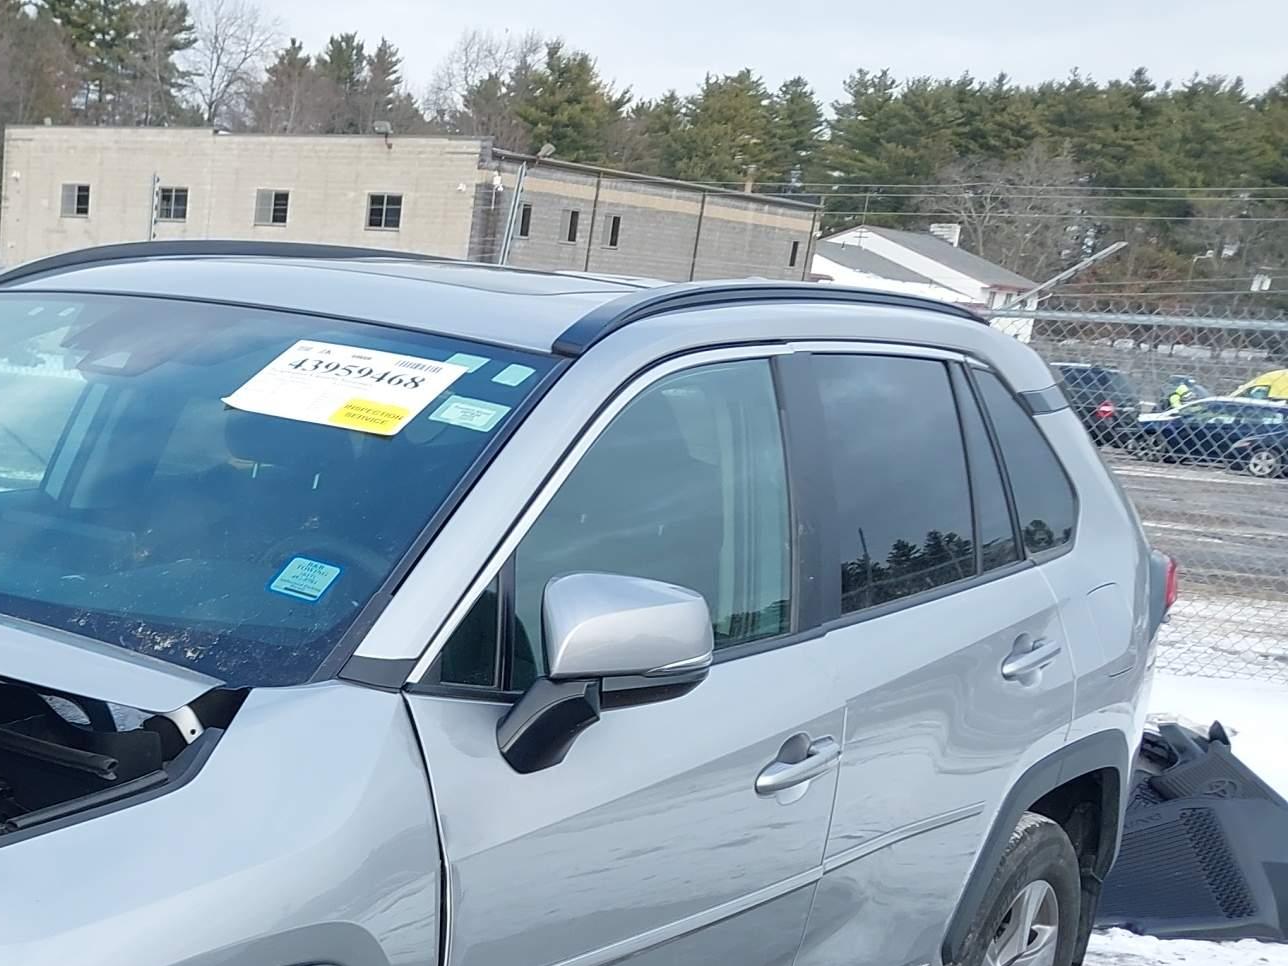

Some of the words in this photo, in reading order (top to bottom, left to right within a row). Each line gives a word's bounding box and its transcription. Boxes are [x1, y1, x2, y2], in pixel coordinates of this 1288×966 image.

[287, 357, 426, 390] 43959468
[343, 403, 405, 421] INSPECTION
[343, 411, 387, 425] SERVICE
